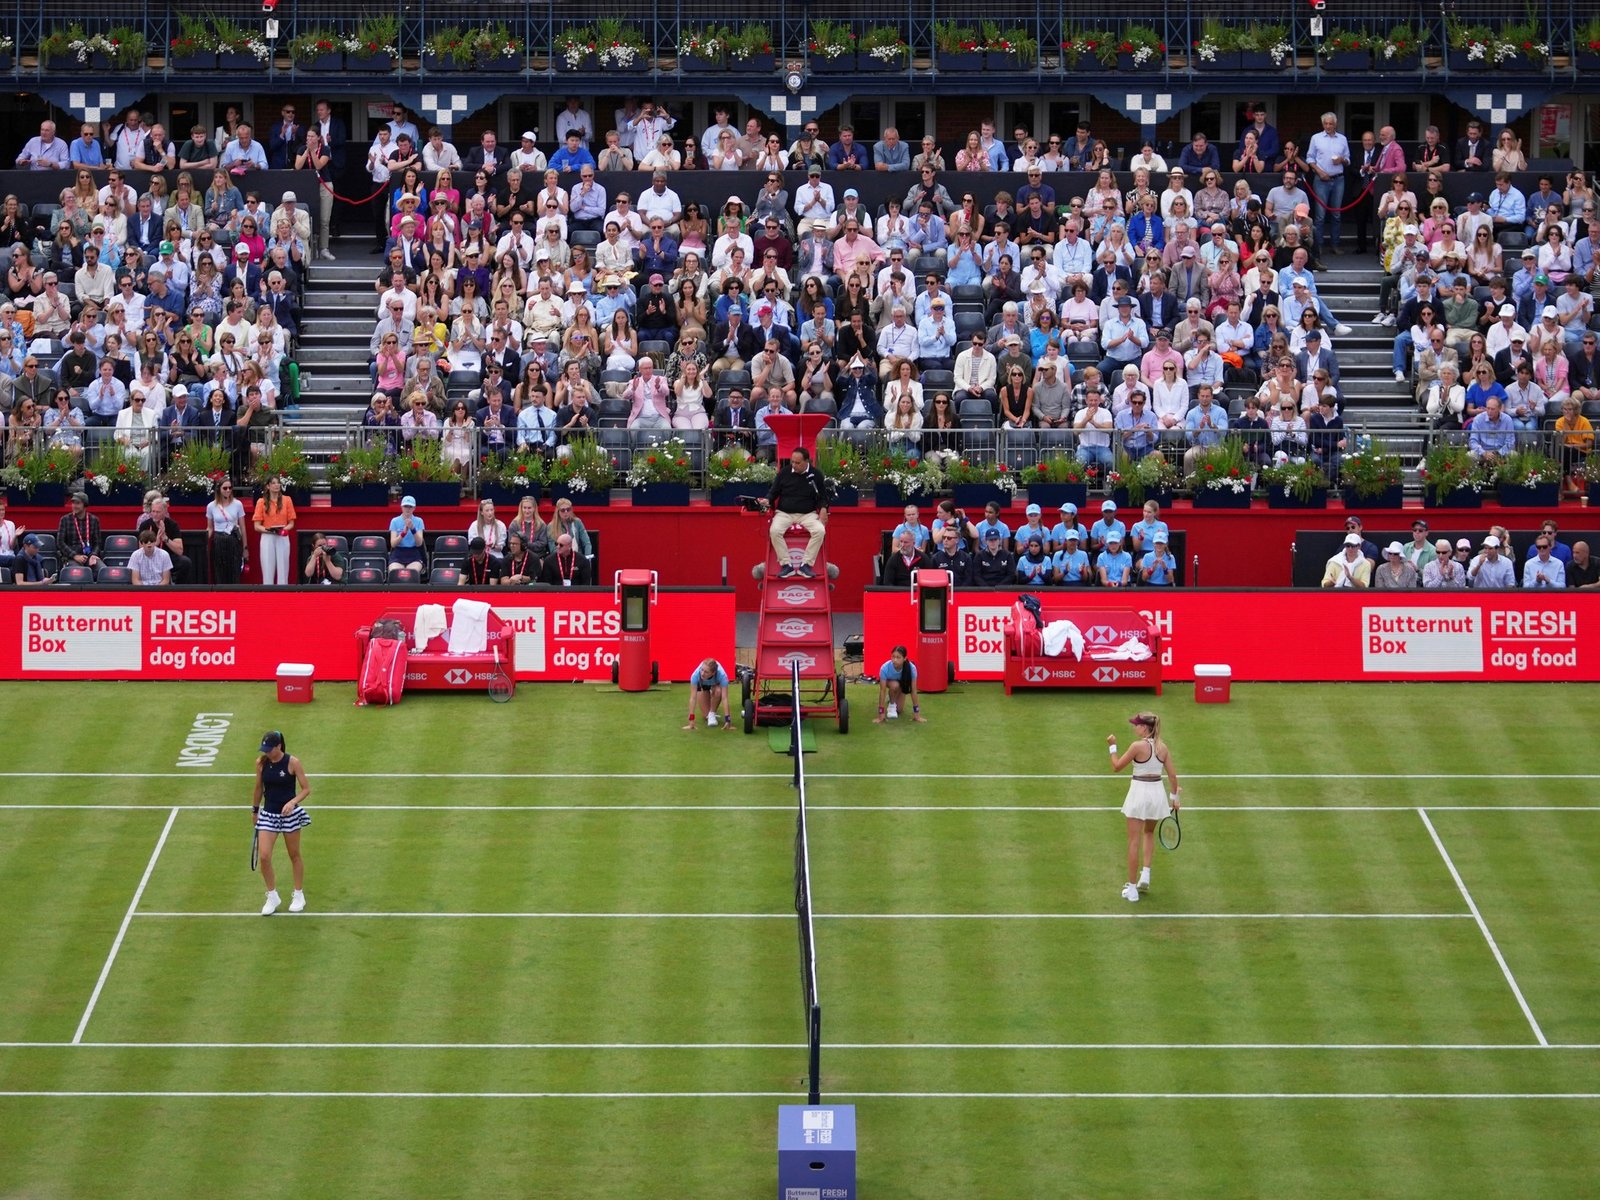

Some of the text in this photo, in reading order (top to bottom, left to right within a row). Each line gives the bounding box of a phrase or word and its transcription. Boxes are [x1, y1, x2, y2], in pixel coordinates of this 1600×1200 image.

[28, 612, 133, 632] Butternut
[150, 609, 236, 634] FRESH
[553, 610, 620, 635] FRES
[1368, 614, 1473, 633] Butternut
[1490, 610, 1577, 635] FRESH
[28, 634, 66, 653] Box
[1120, 629, 1147, 639] HSBC
[965, 635, 1003, 653] Box
[1369, 635, 1407, 654] Box
[149, 646, 235, 669] dog food
[553, 647, 589, 670] dog
[1490, 647, 1577, 670] dog food
[1052, 670, 1076, 678] HSBC
[1122, 670, 1146, 678] HSBC
[176, 712, 233, 767] LONDON
[822, 1188, 848, 1197] FRESH
